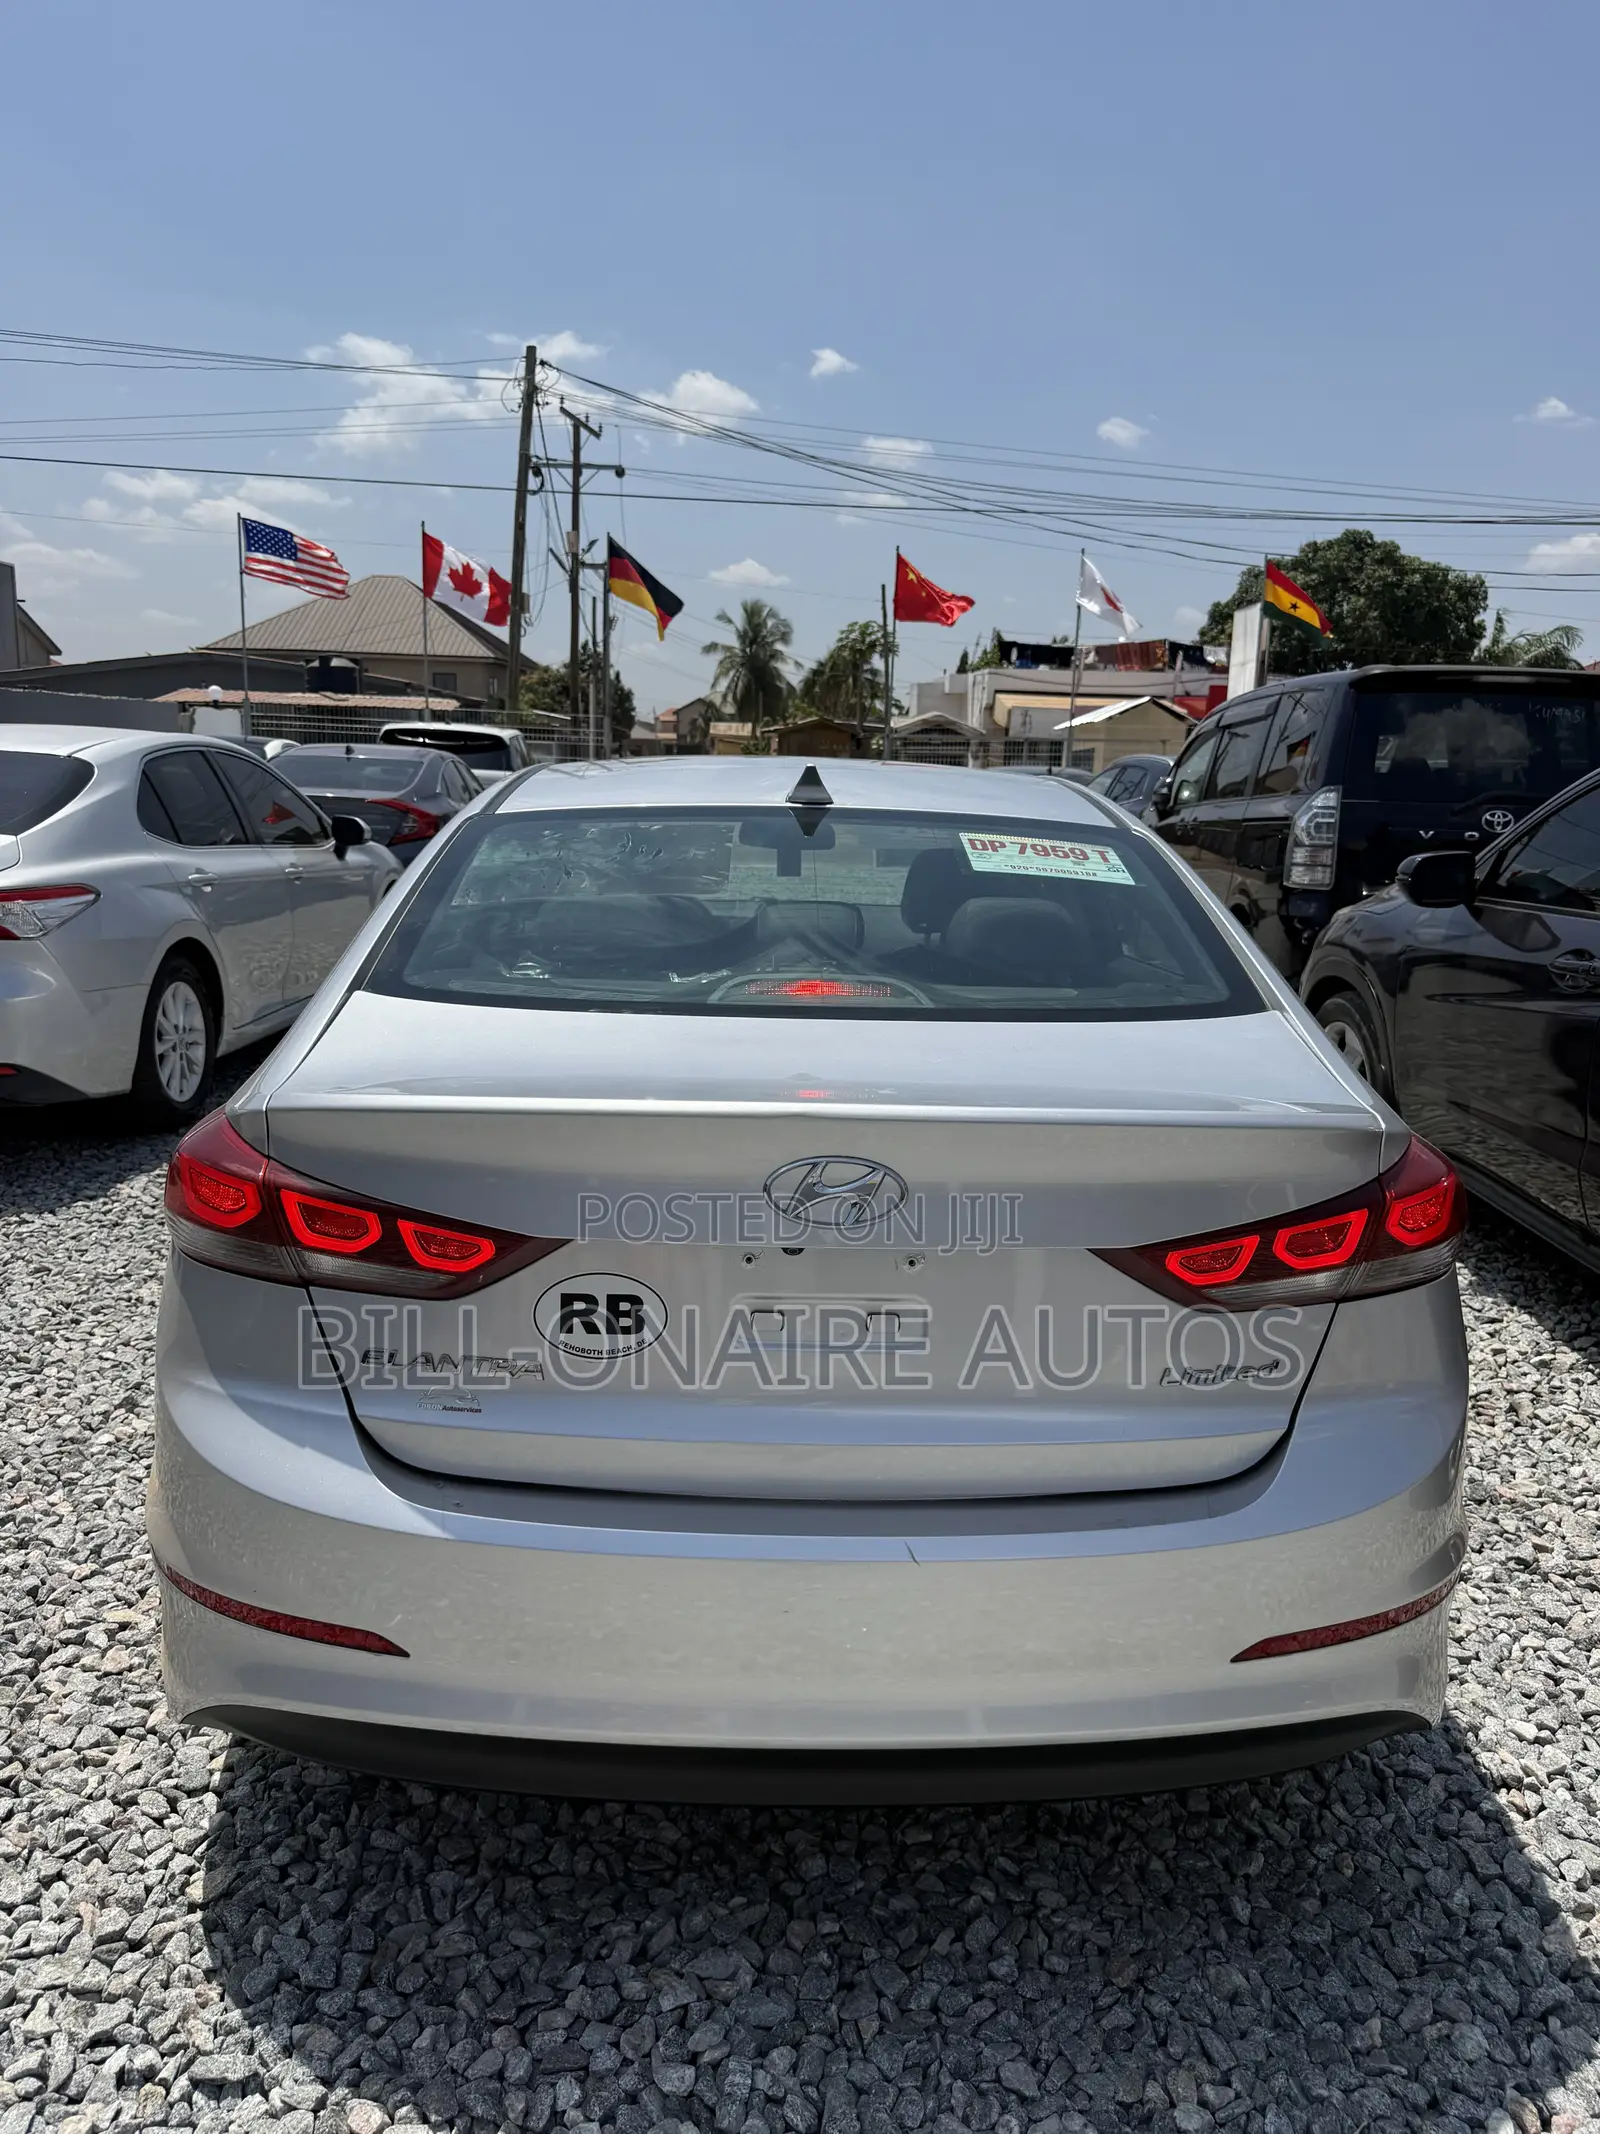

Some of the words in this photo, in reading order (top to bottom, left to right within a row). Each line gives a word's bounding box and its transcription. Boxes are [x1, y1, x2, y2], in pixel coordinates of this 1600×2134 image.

[967, 838, 1007, 853] DP
[1010, 841, 1089, 861] 7959
[1090, 850, 1111, 864] T
[559, 1292, 646, 1336] RB
[558, 1339, 603, 1356] REHOBOTH
[636, 1338, 648, 1348] DE
[360, 1347, 545, 1381] ELANTRA
[1159, 1359, 1280, 1387] Limited
